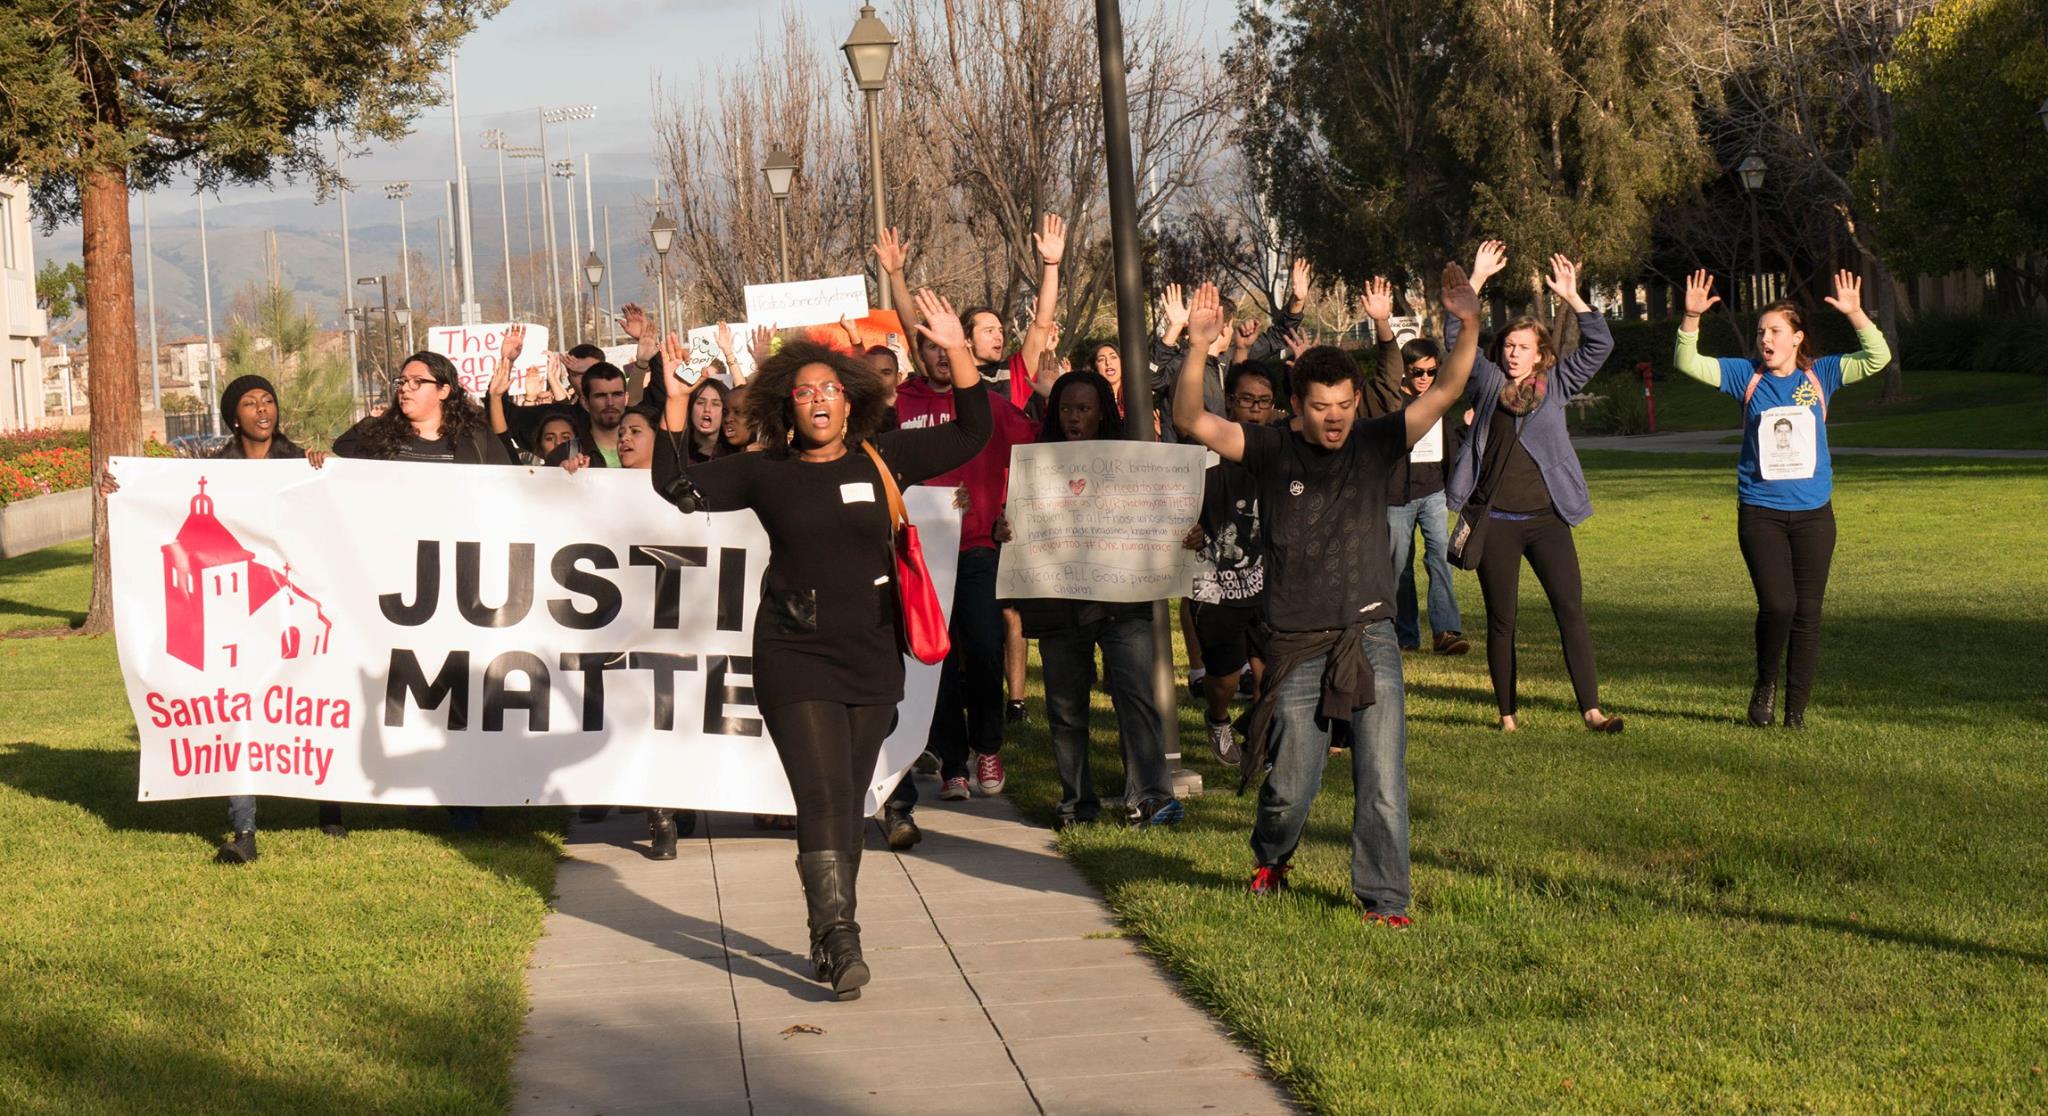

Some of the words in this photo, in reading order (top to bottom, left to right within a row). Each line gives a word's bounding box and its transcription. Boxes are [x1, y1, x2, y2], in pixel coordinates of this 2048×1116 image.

[1091, 457, 1123, 474] OUR
[379, 540, 746, 632] JUSTI
[1064, 564, 1088, 582] ALL
[1220, 589, 1242, 600] YOU
[146, 687, 252, 729] Santa
[263, 684, 351, 729] Clara
[384, 648, 763, 737] MATTE
[170, 734, 335, 786] University
